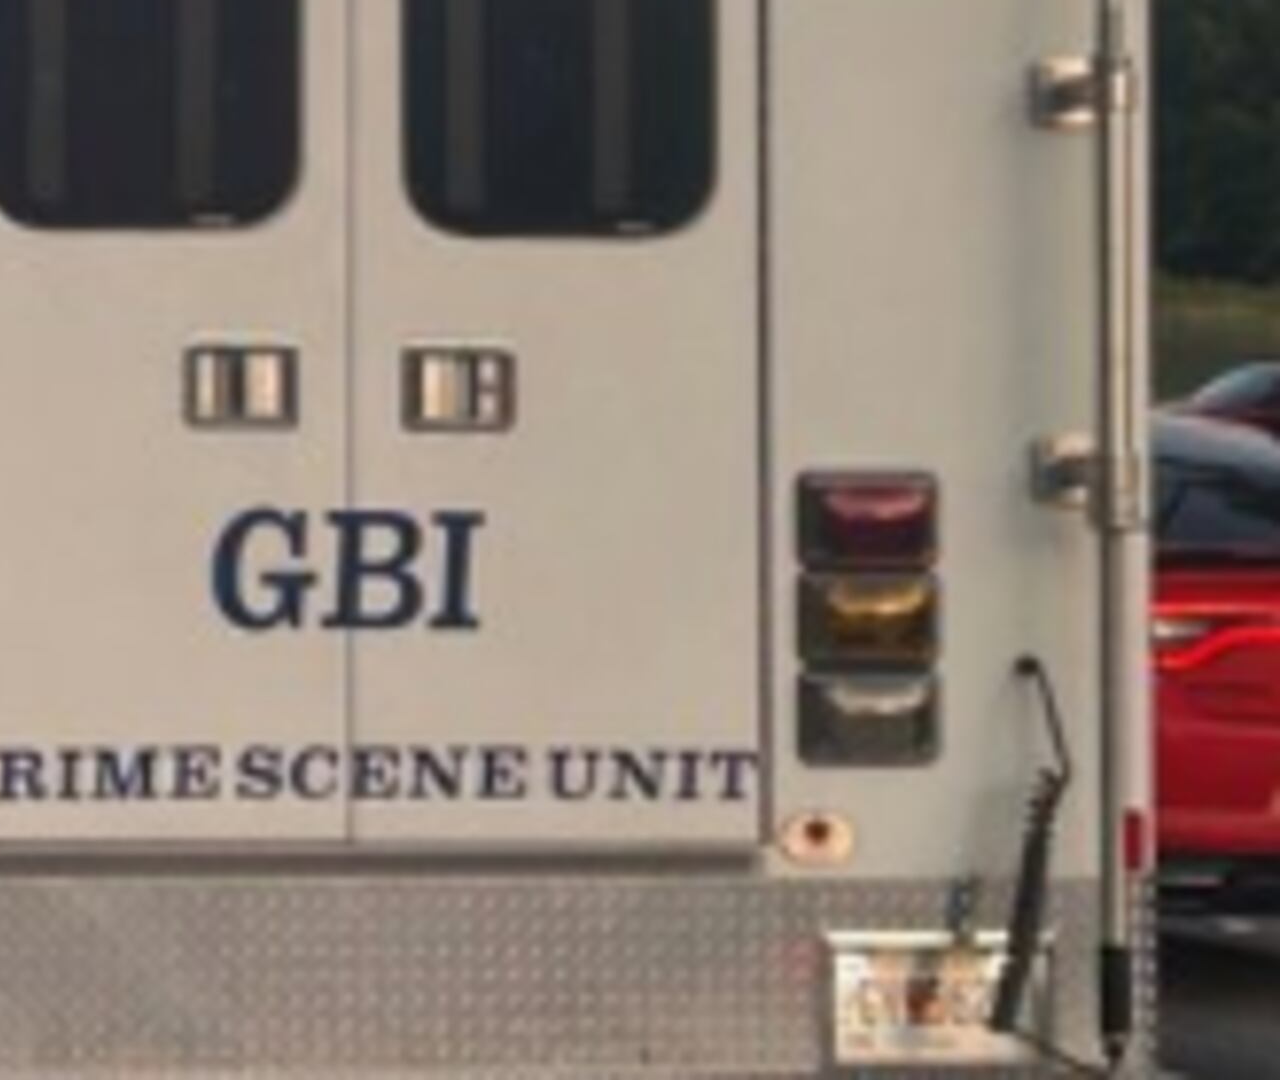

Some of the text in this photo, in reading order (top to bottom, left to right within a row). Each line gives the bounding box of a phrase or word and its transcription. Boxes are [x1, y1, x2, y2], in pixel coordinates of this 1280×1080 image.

[210, 505, 486, 632] GBI
[236, 744, 527, 803] SCENE
[548, 746, 761, 804] UNIT
